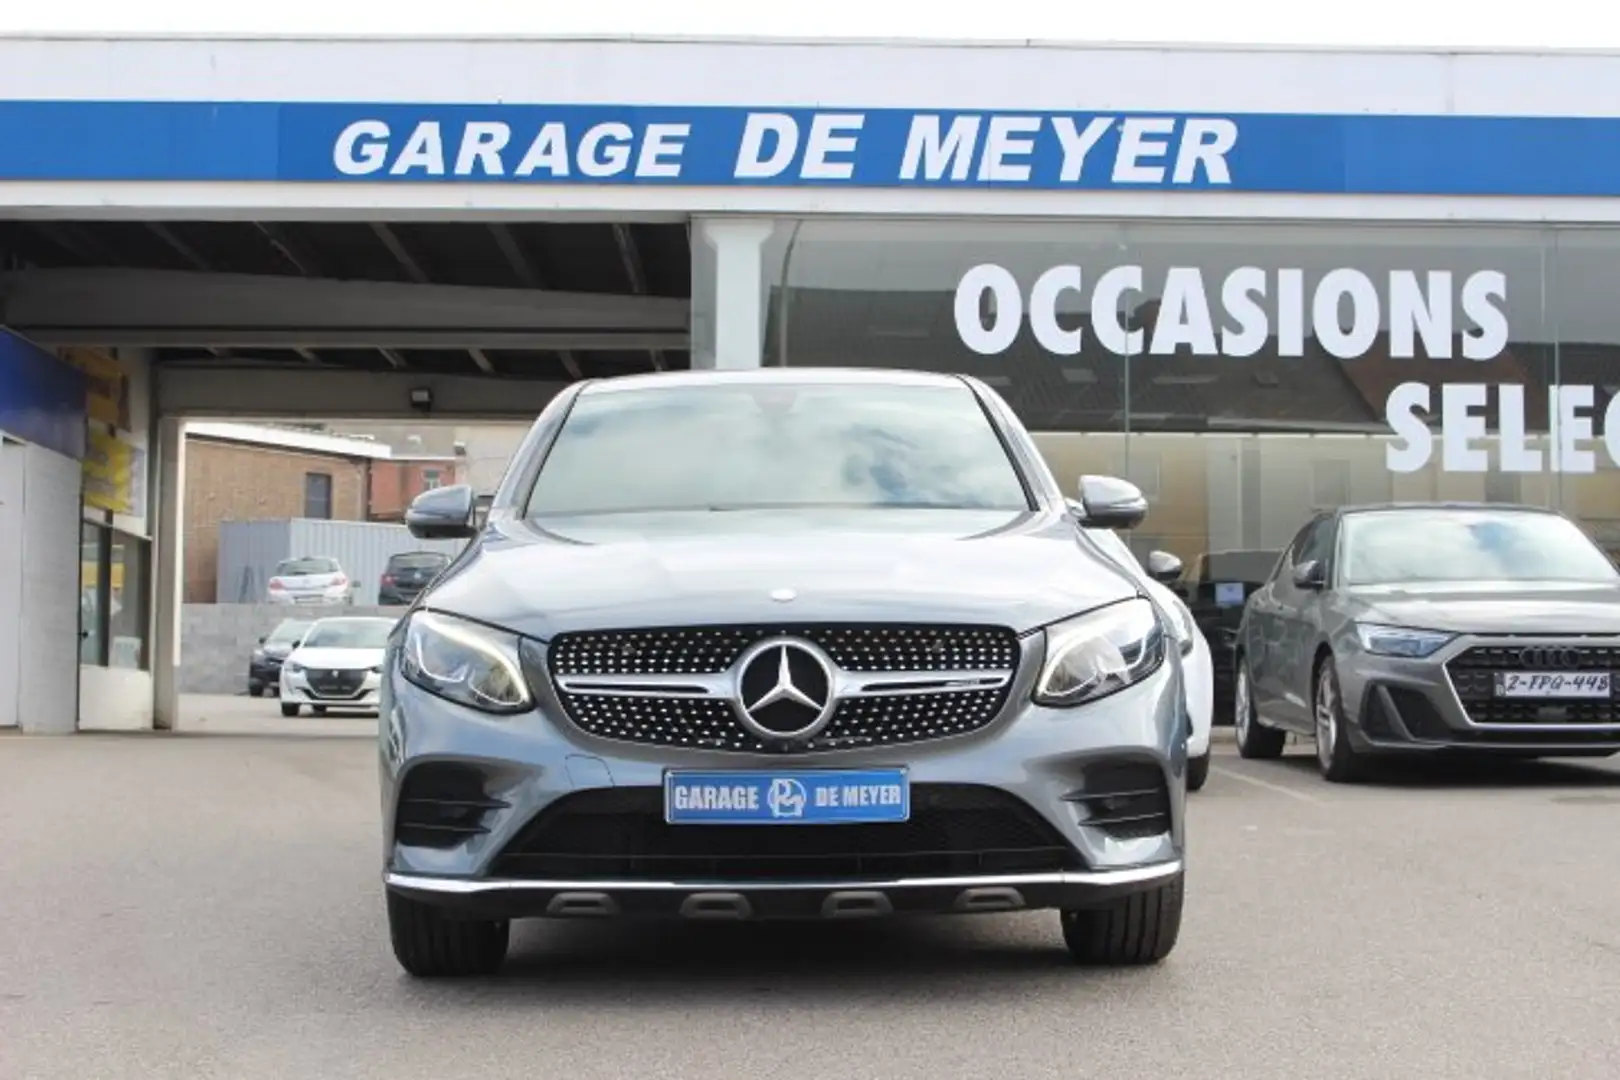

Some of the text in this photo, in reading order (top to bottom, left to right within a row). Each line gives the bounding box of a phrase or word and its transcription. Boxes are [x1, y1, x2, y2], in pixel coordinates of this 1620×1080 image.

[333, 112, 1239, 184] GARAGE DE MEYER
[953, 263, 1510, 361] OCCASIONS
[674, 785, 760, 810] GARAGE
[814, 786, 840, 807] DE
[843, 784, 902, 808] MEYER
